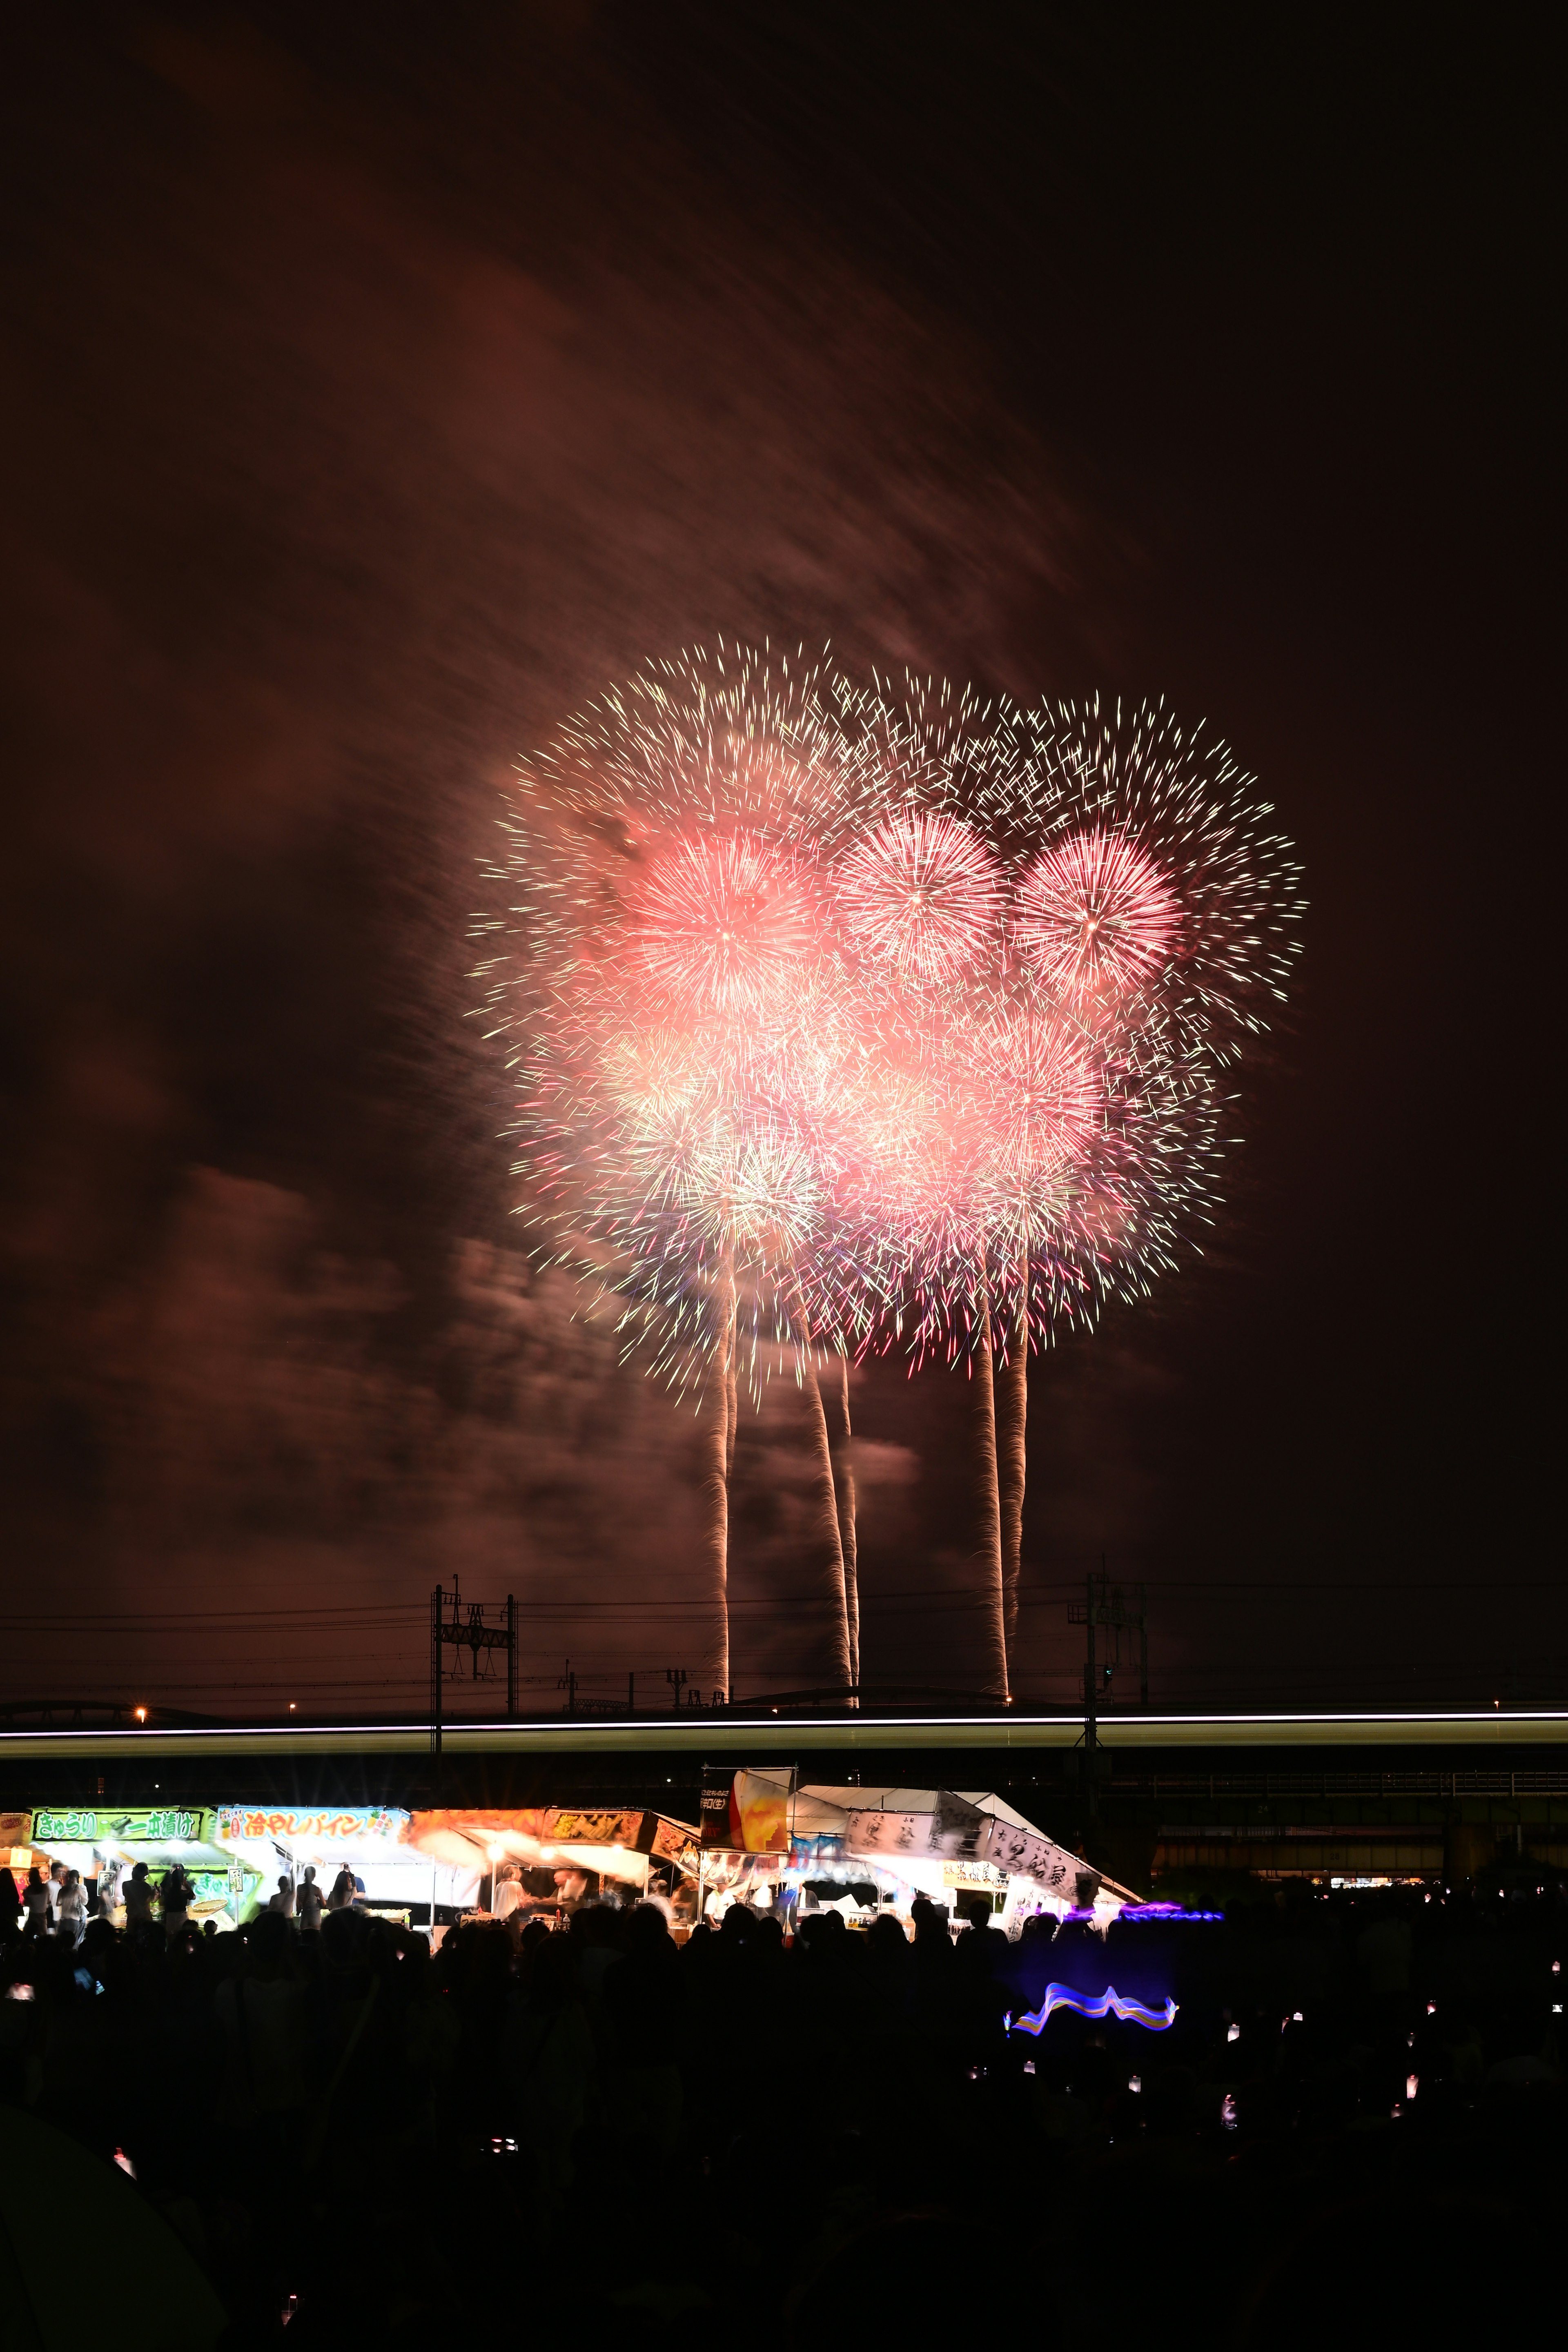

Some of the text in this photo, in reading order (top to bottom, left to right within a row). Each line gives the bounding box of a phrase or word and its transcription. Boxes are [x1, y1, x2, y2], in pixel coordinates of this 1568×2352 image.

[38, 1812, 97, 1839] きゅうり
[127, 1812, 194, 1839] 一本漬け
[243, 1811, 365, 1838] 冷やしパイン
